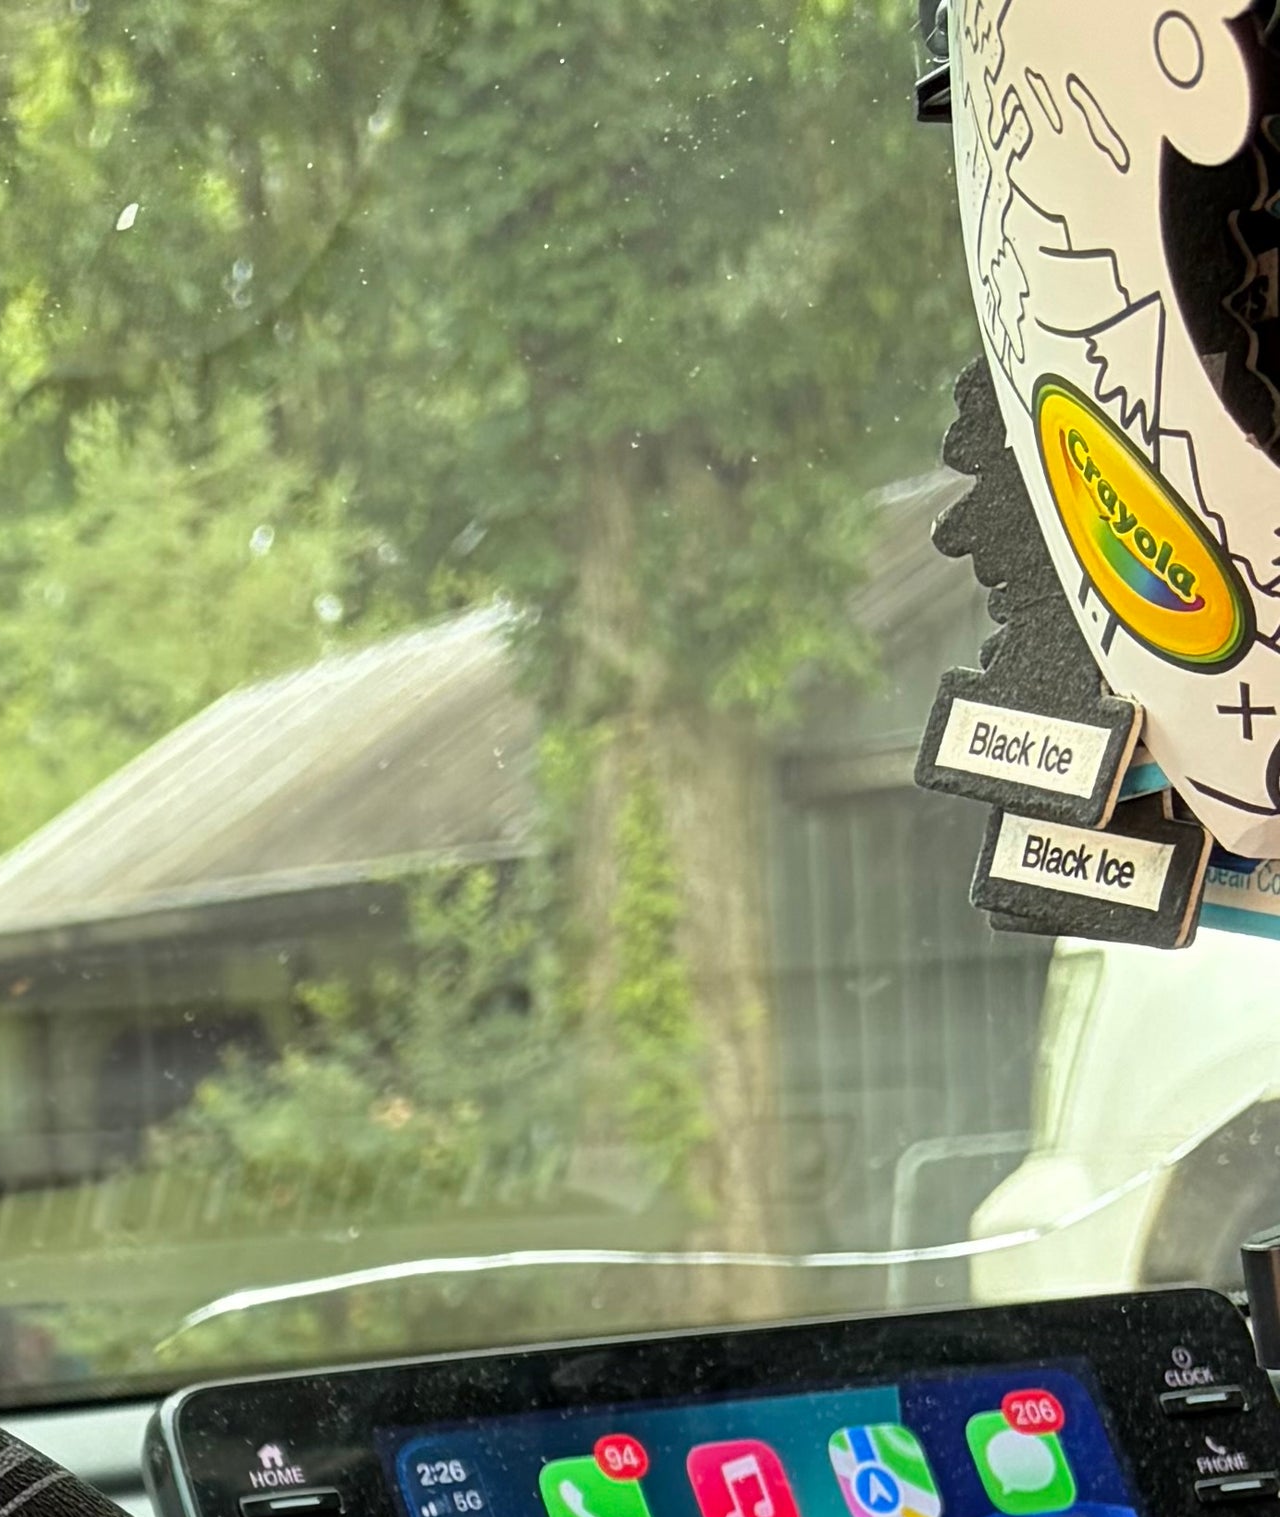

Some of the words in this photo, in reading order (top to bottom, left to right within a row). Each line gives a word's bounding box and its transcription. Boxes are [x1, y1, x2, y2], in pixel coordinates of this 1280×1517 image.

[1067, 428, 1196, 598] Crayola
[968, 721, 1035, 767] Black
[1037, 735, 1073, 775] Ice
[1021, 834, 1093, 880] Black
[1095, 848, 1135, 889] Ice
[1164, 1367, 1214, 1387] CLOCK
[1011, 1399, 1056, 1425] 206
[605, 1444, 639, 1471] 94
[1196, 1453, 1249, 1474] PHONE
[249, 1466, 305, 1489] HOME
[416, 1459, 467, 1486] 2:26
[453, 1489, 483, 1512] 5G
